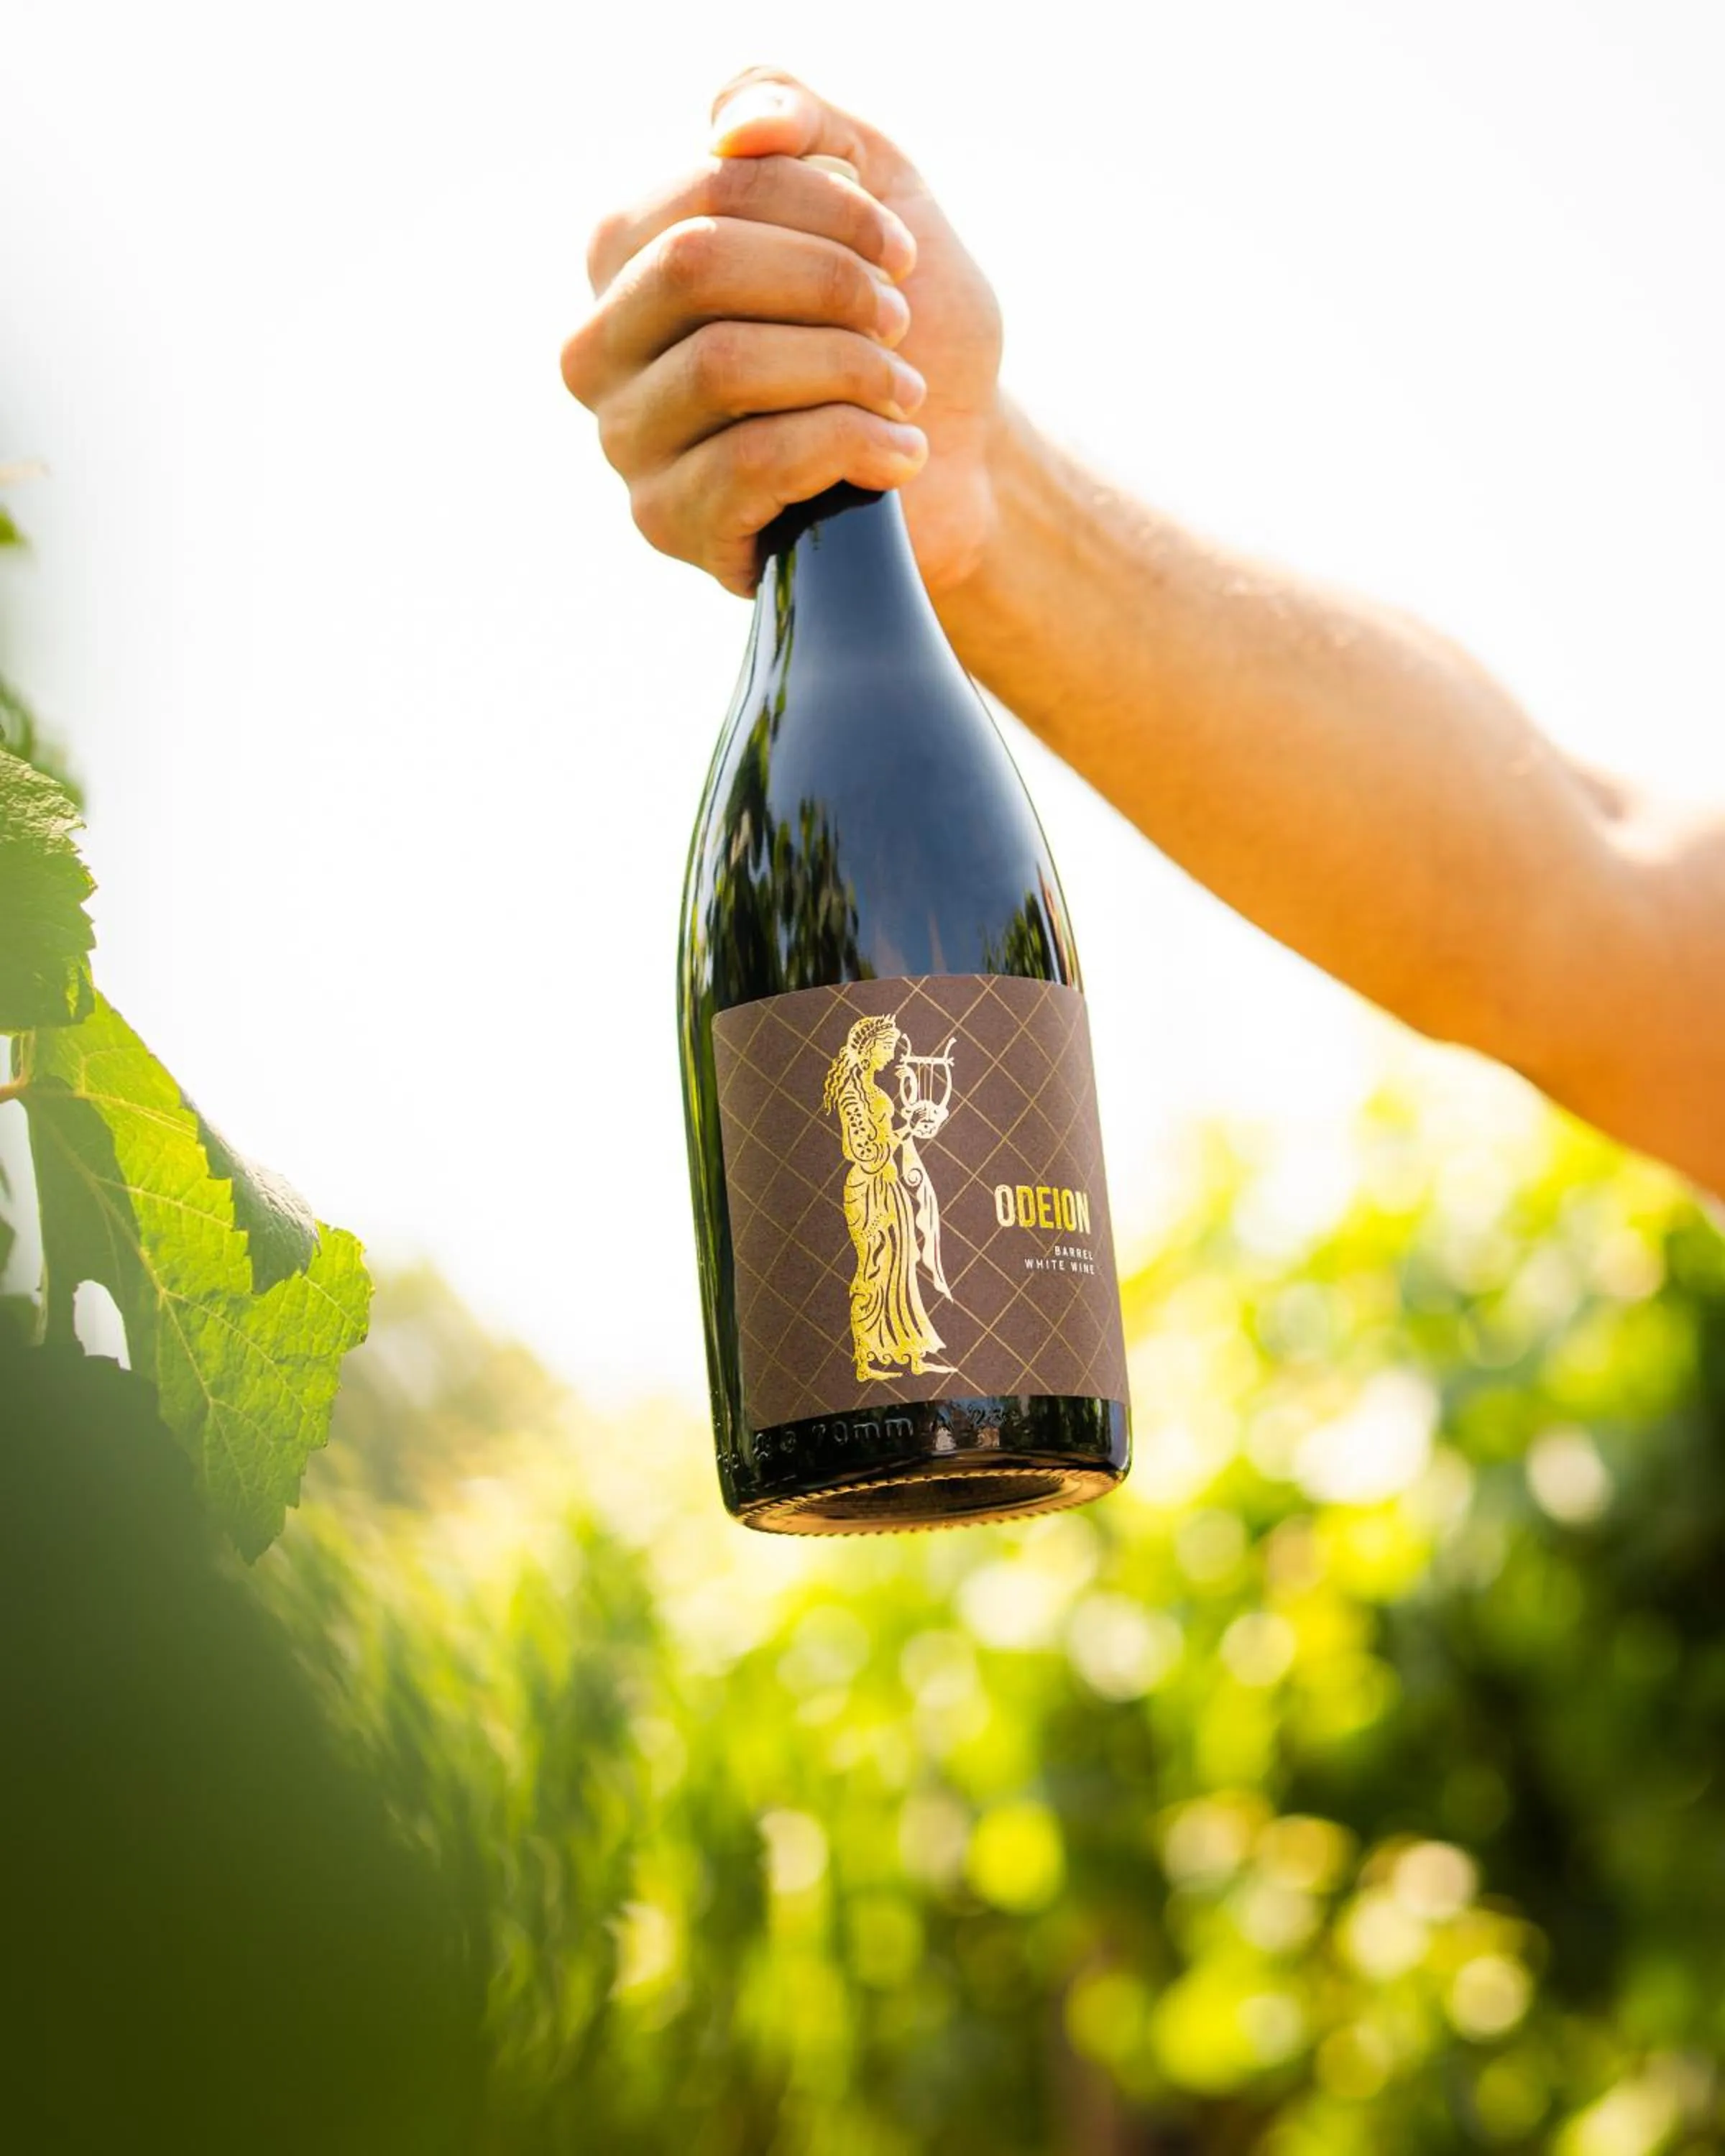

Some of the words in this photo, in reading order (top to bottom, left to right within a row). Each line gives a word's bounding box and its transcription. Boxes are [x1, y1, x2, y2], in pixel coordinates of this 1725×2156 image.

[994, 1184, 1091, 1235] ODEION
[1054, 1245, 1093, 1260] BARREL
[1024, 1258, 1064, 1271] WHITE
[1070, 1261, 1095, 1275] WINE
